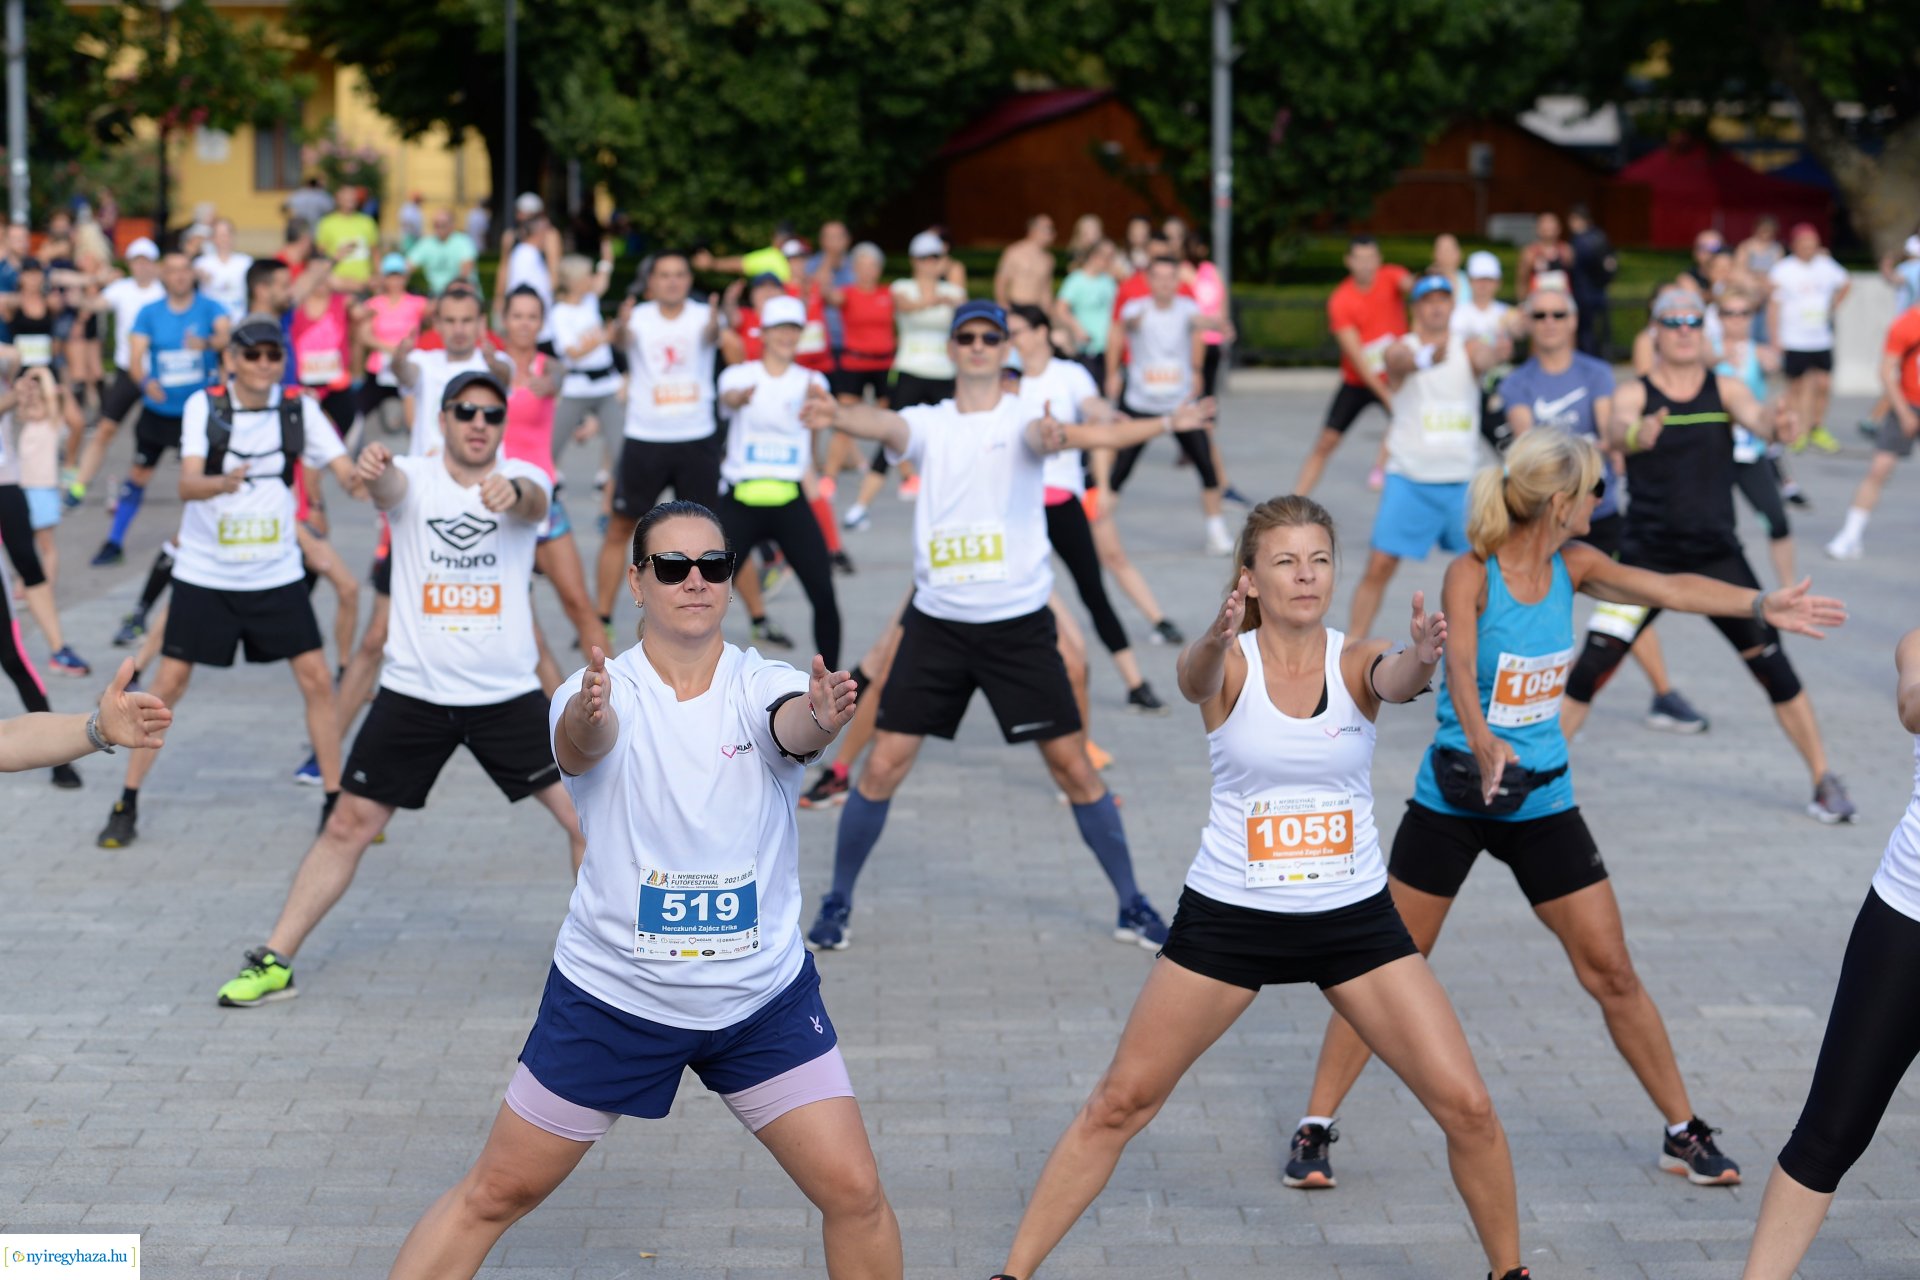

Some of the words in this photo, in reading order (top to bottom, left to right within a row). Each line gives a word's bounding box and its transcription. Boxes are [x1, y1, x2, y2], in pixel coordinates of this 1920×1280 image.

[430, 550, 497, 568] umbro
[427, 585, 497, 609] 1099
[1256, 814, 1348, 848] 1058
[661, 892, 740, 922] 519
